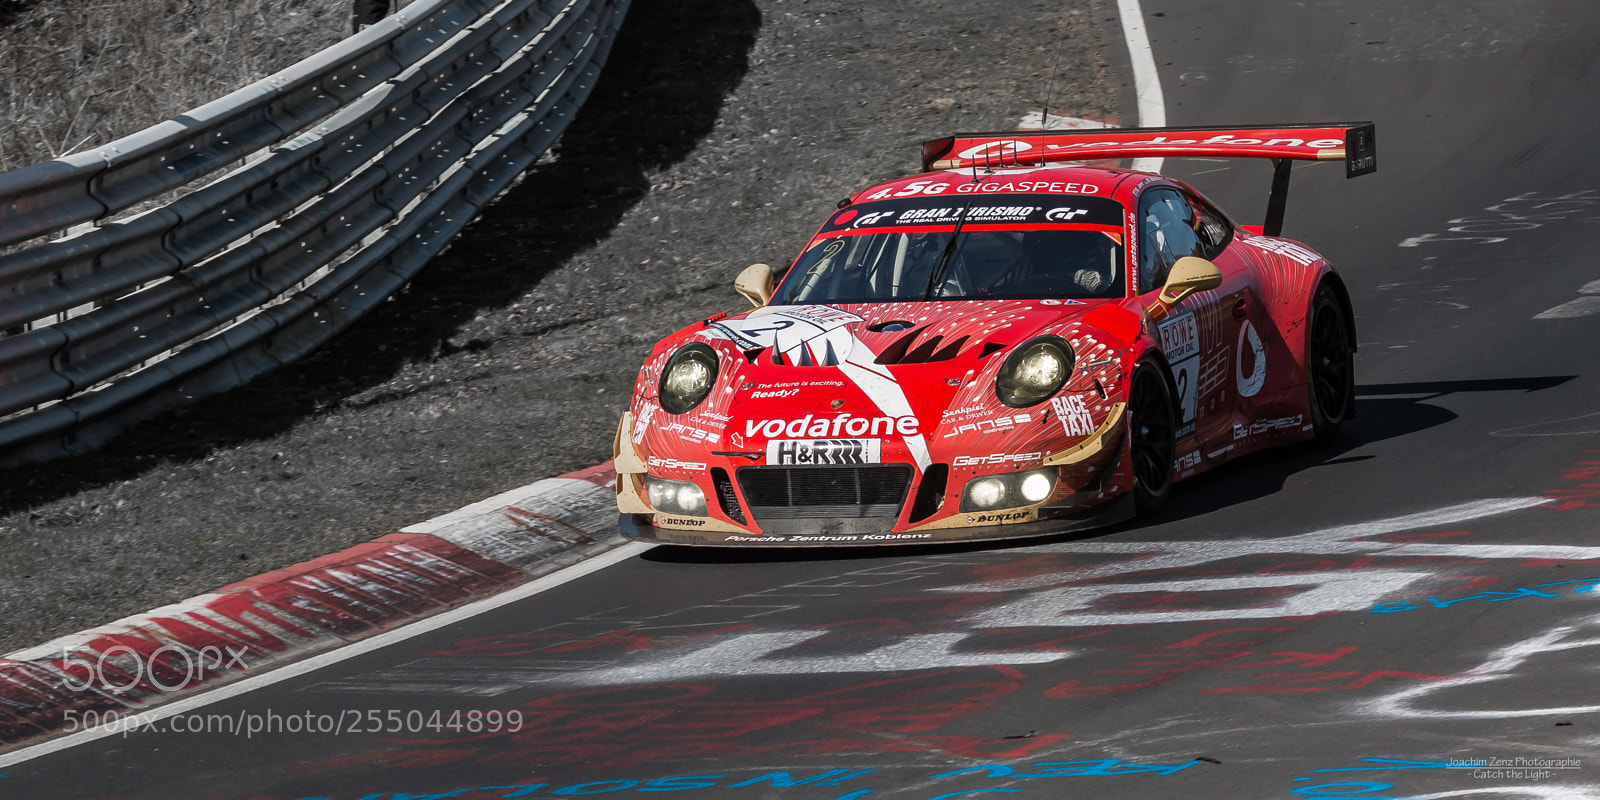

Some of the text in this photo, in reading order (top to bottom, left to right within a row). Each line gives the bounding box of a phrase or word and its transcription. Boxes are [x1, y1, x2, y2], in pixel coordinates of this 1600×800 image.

[1045, 135, 1344, 150] vodafone
[866, 180, 1099, 201] 4.5G GIGASPEED
[899, 207, 953, 220] GRAN
[806, 239, 845, 275] 2
[1127, 212, 1139, 292] www.getspeed.de
[739, 319, 795, 338] 2
[1163, 318, 1195, 352] ROWE
[1165, 342, 1195, 361] MOTOR OIL
[750, 388, 800, 399] Ready?
[941, 402, 986, 418] Senkpiel
[1050, 395, 1091, 415] RACE
[745, 412, 919, 438] vodafone
[940, 416, 957, 425] CAR
[965, 409, 994, 420] DRIVER
[1057, 413, 1096, 437] TAXI
[943, 416, 1013, 439] JANS
[666, 518, 706, 527] DUNLOP
[976, 511, 1030, 523] DUNLOP
[724, 535, 786, 543] Porsche
[861, 533, 933, 541] Koblenz
